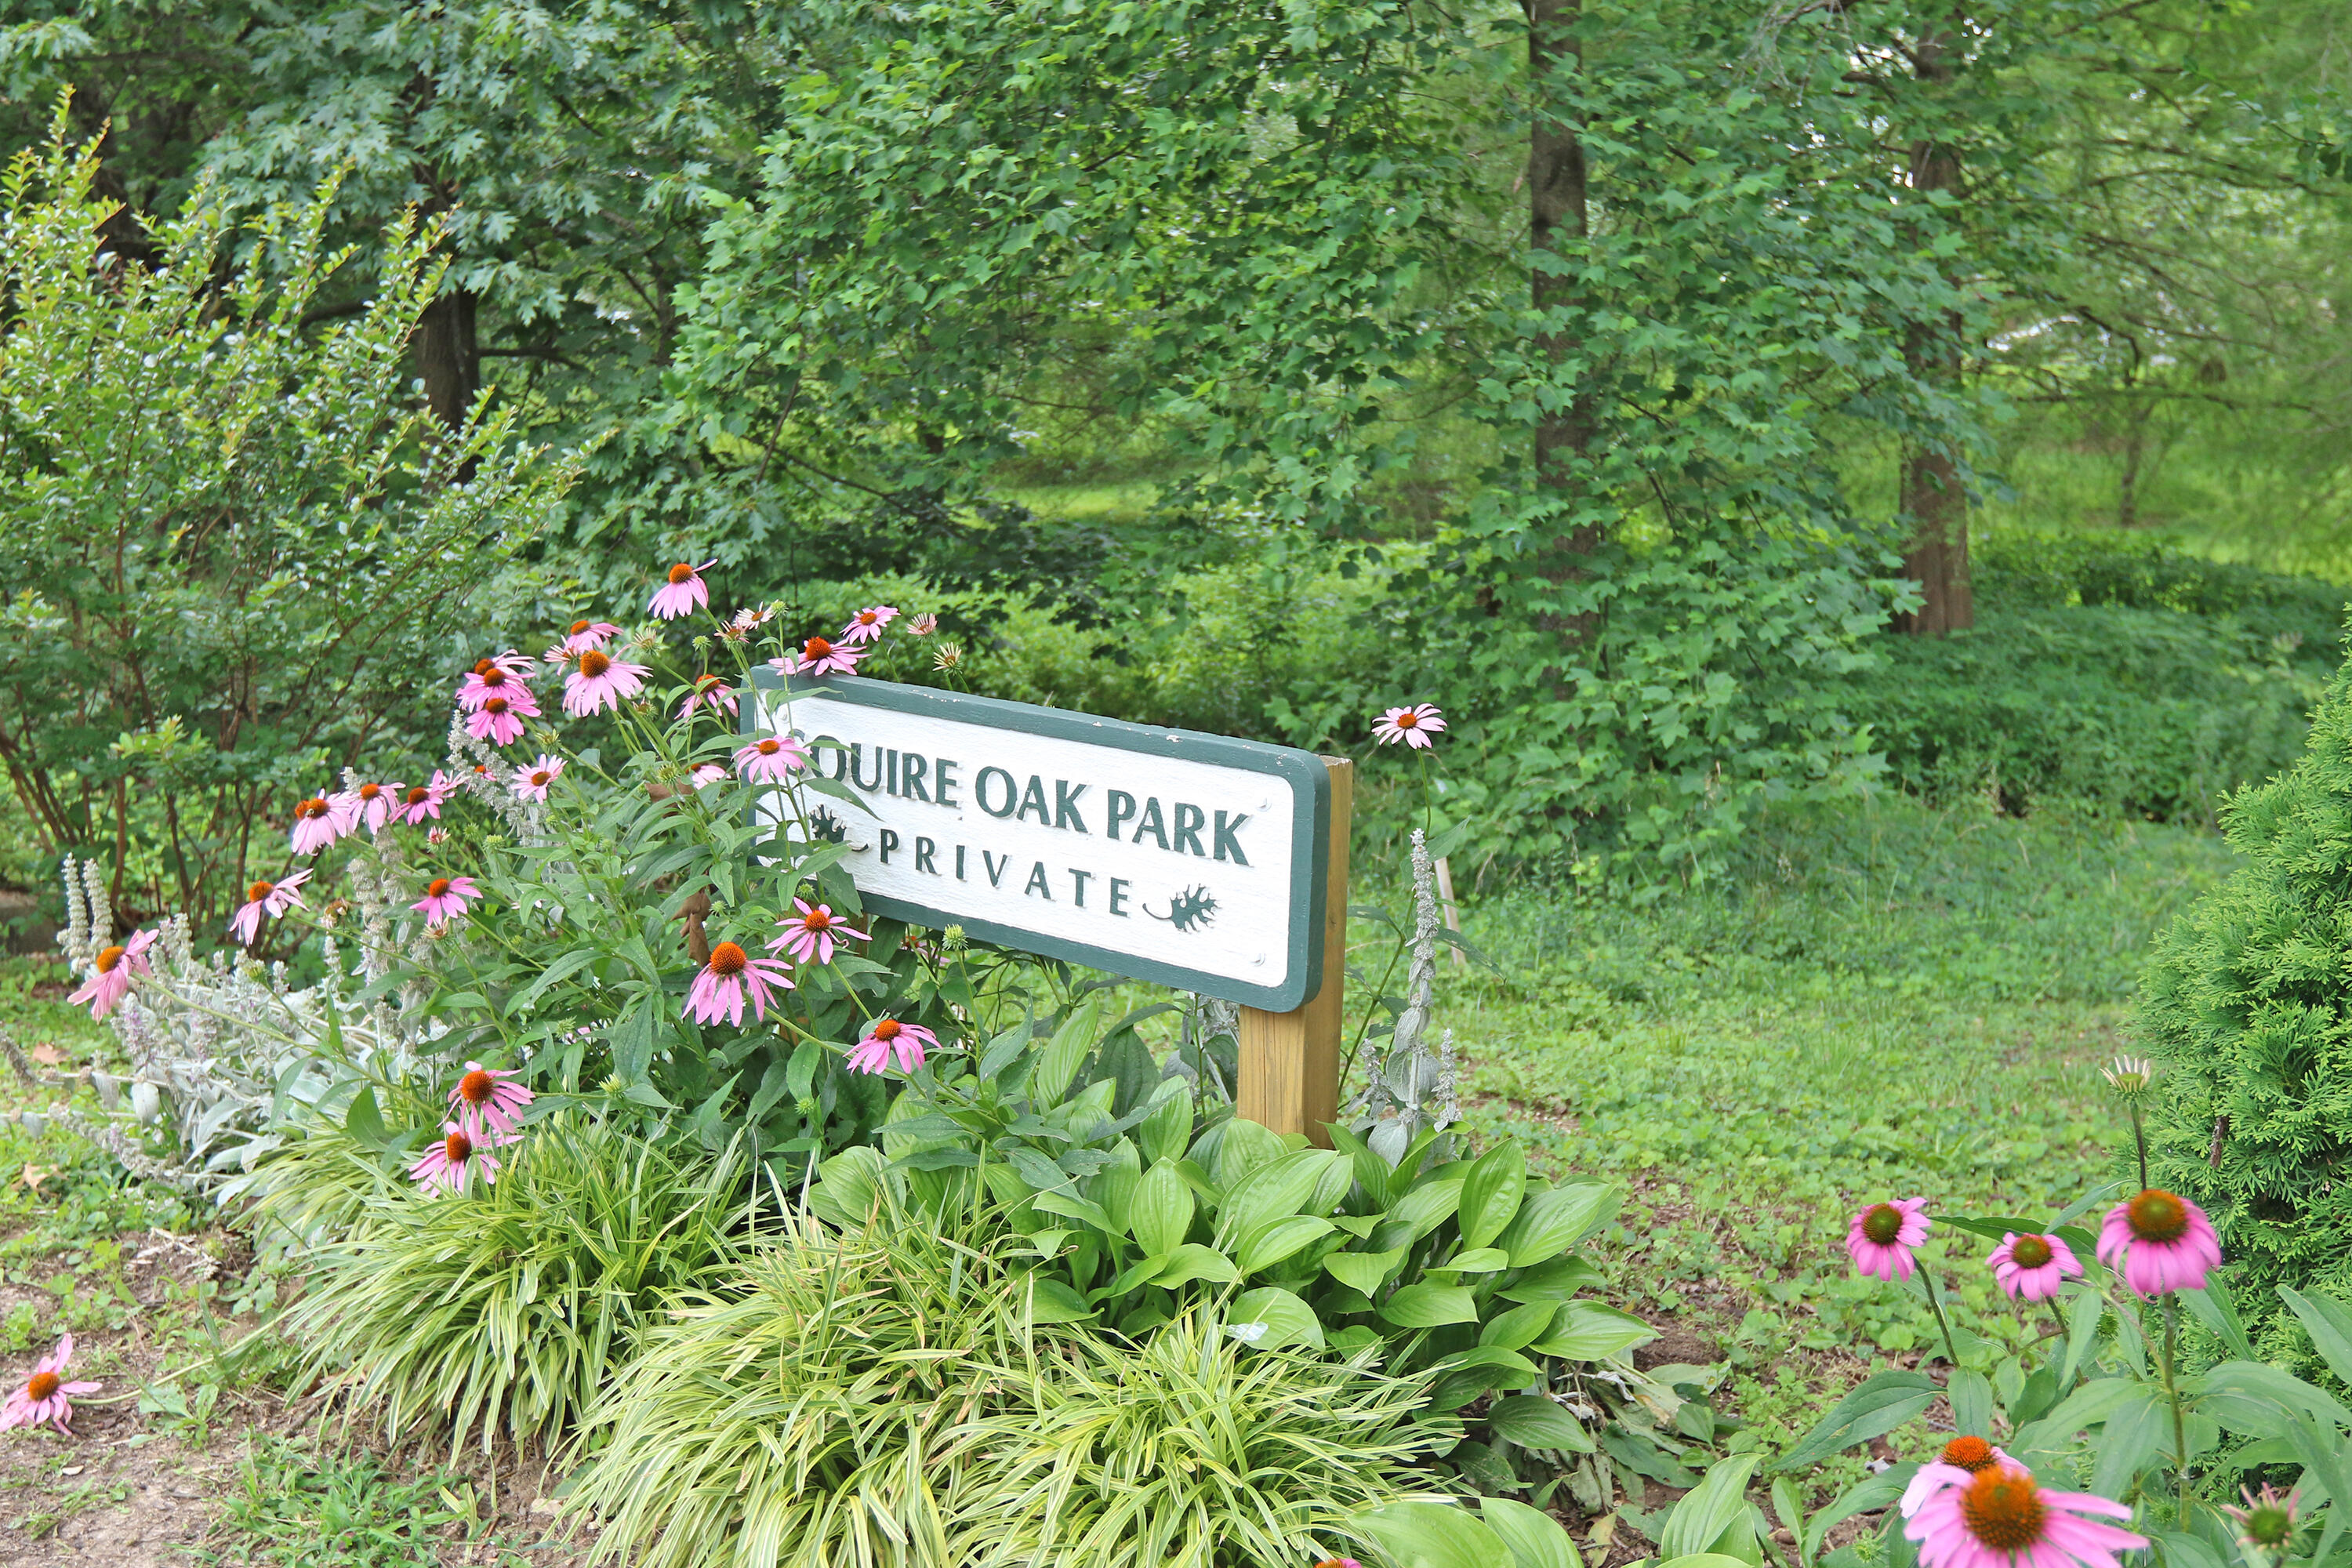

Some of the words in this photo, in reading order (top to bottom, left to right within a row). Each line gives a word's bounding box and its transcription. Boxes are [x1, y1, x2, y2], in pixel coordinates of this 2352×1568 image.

[975, 765, 1090, 834] OAK
[1106, 788, 1251, 866] PARK
[880, 828, 1130, 917] PRIVATE
